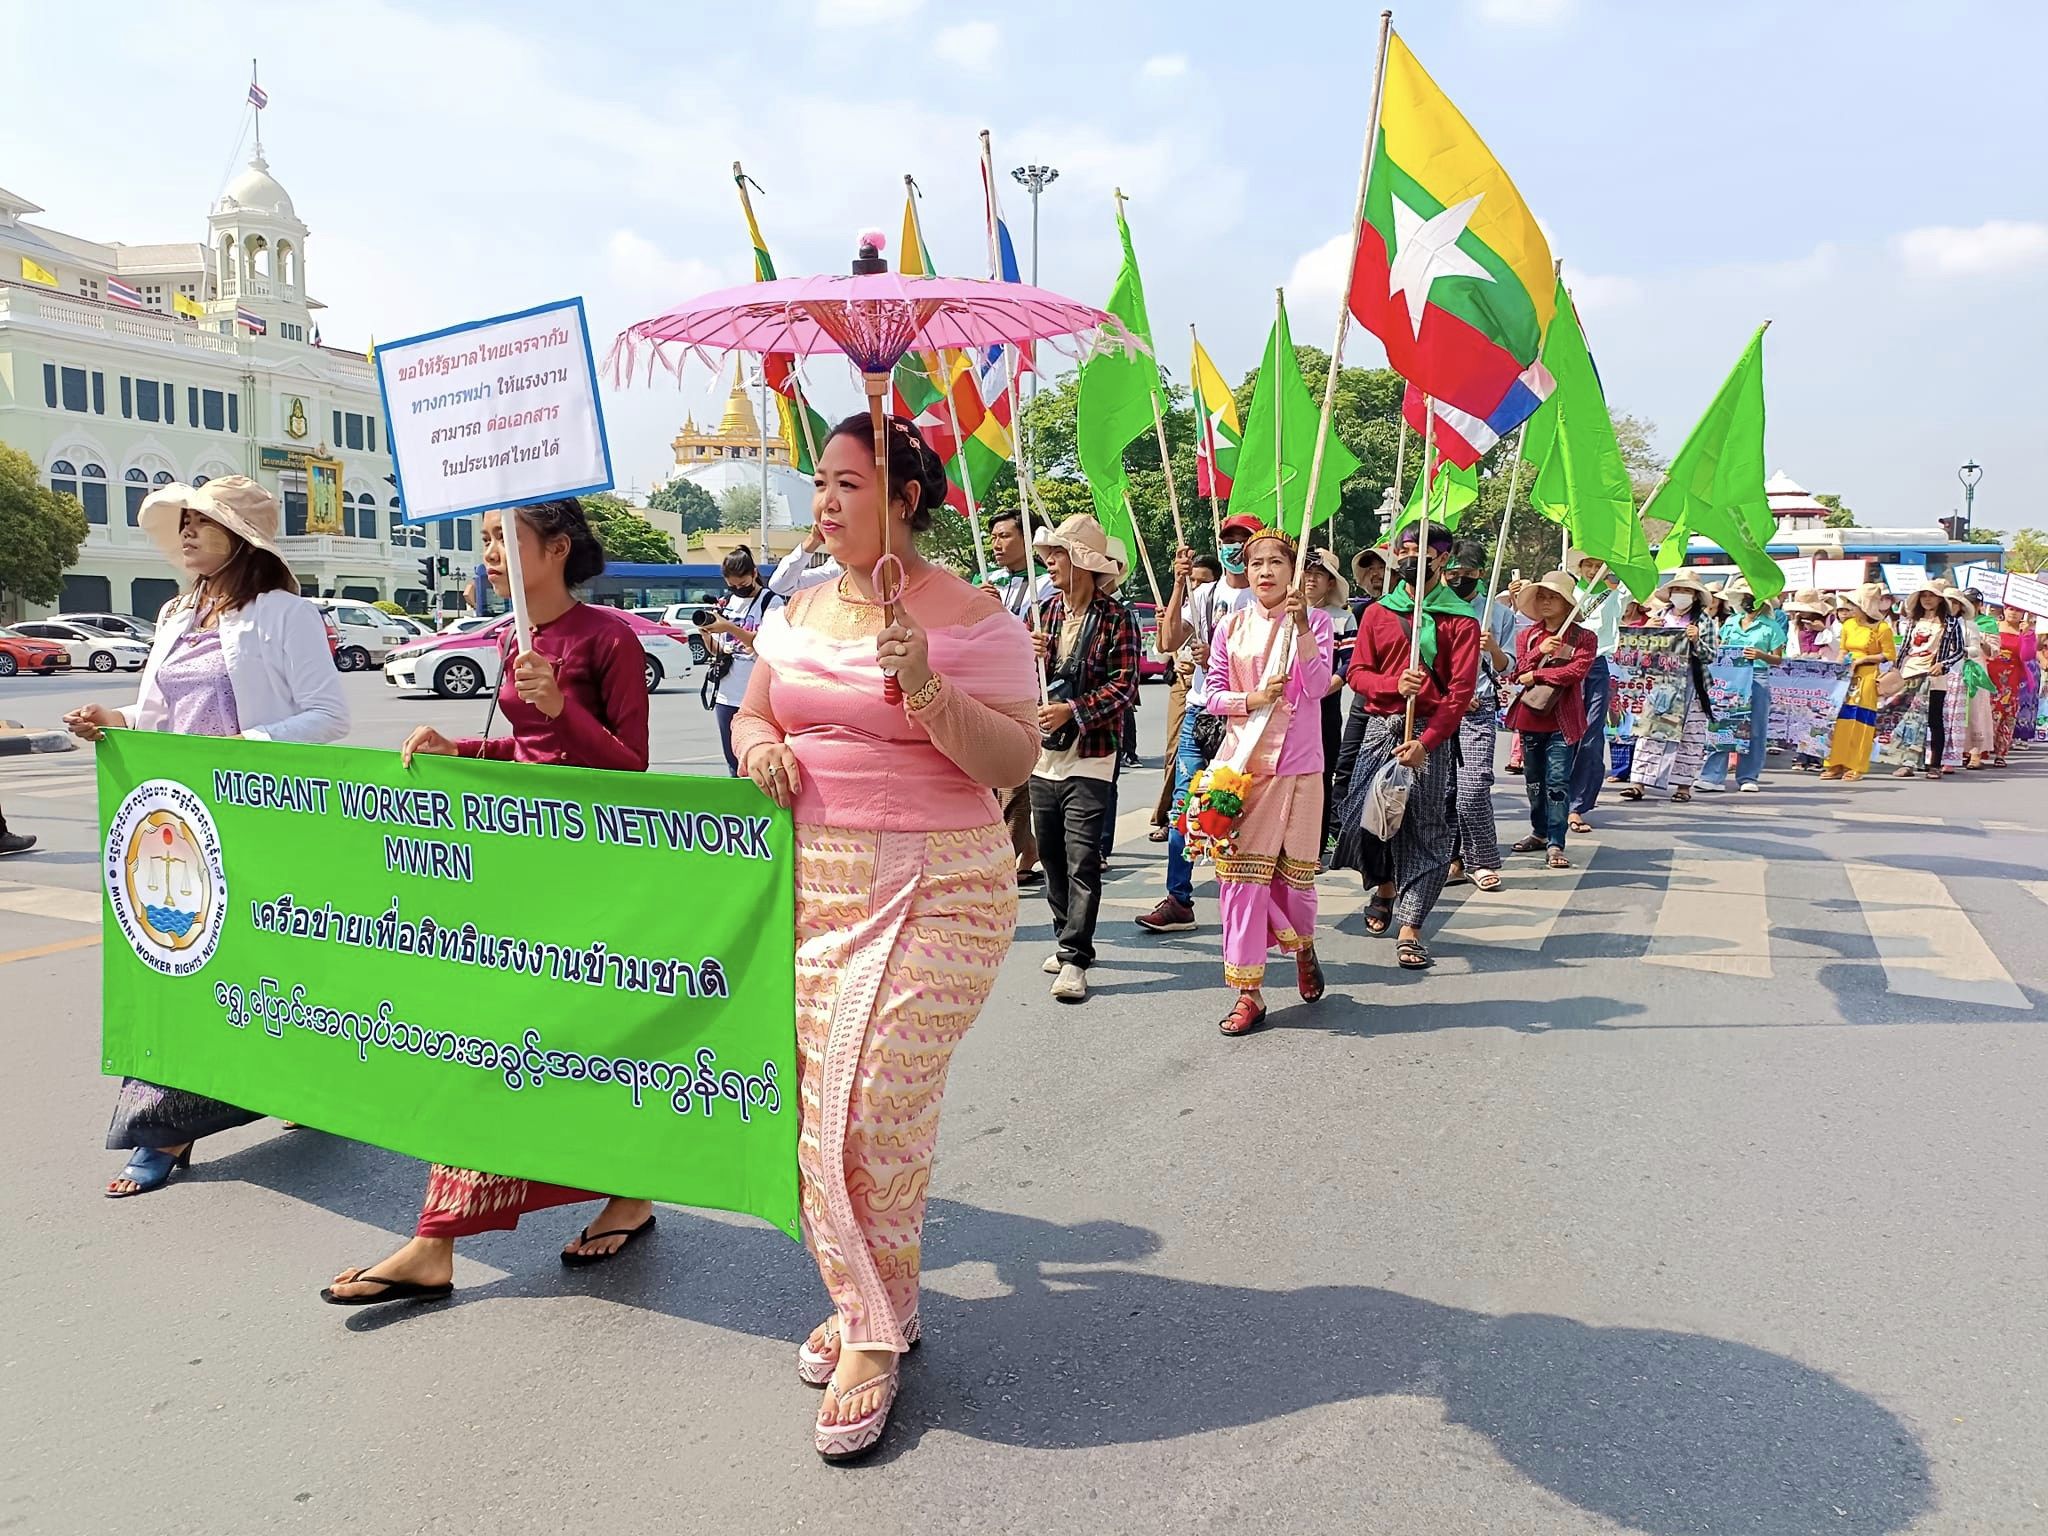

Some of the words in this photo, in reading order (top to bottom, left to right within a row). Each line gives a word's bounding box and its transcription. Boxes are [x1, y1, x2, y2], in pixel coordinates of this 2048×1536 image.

[398, 327, 569, 381] ขอให้รัฐบาลไทยเจรจากับ
[411, 381, 492, 415] ทางการพม่า
[497, 366, 568, 396] ให้แรงงาน
[430, 420, 482, 445] สามารถ
[486, 404, 560, 433] ต่อเอกสาร
[441, 437, 560, 478] ในประเทศไทยได้
[213, 769, 331, 814] MIGRANT
[338, 781, 455, 829] WORKER
[462, 793, 586, 840] RIGHTS
[593, 804, 772, 860] NETWORK
[384, 835, 473, 882] MWRN
[111, 886, 136, 942] MIGRANT
[135, 942, 171, 973] WORKER
[174, 956, 203, 975] RIGHTS
[202, 902, 225, 959] NETWORK
[250, 894, 730, 1001] เครือข่ายเพื่อสิทธิแรงงานข้ามชาติ
